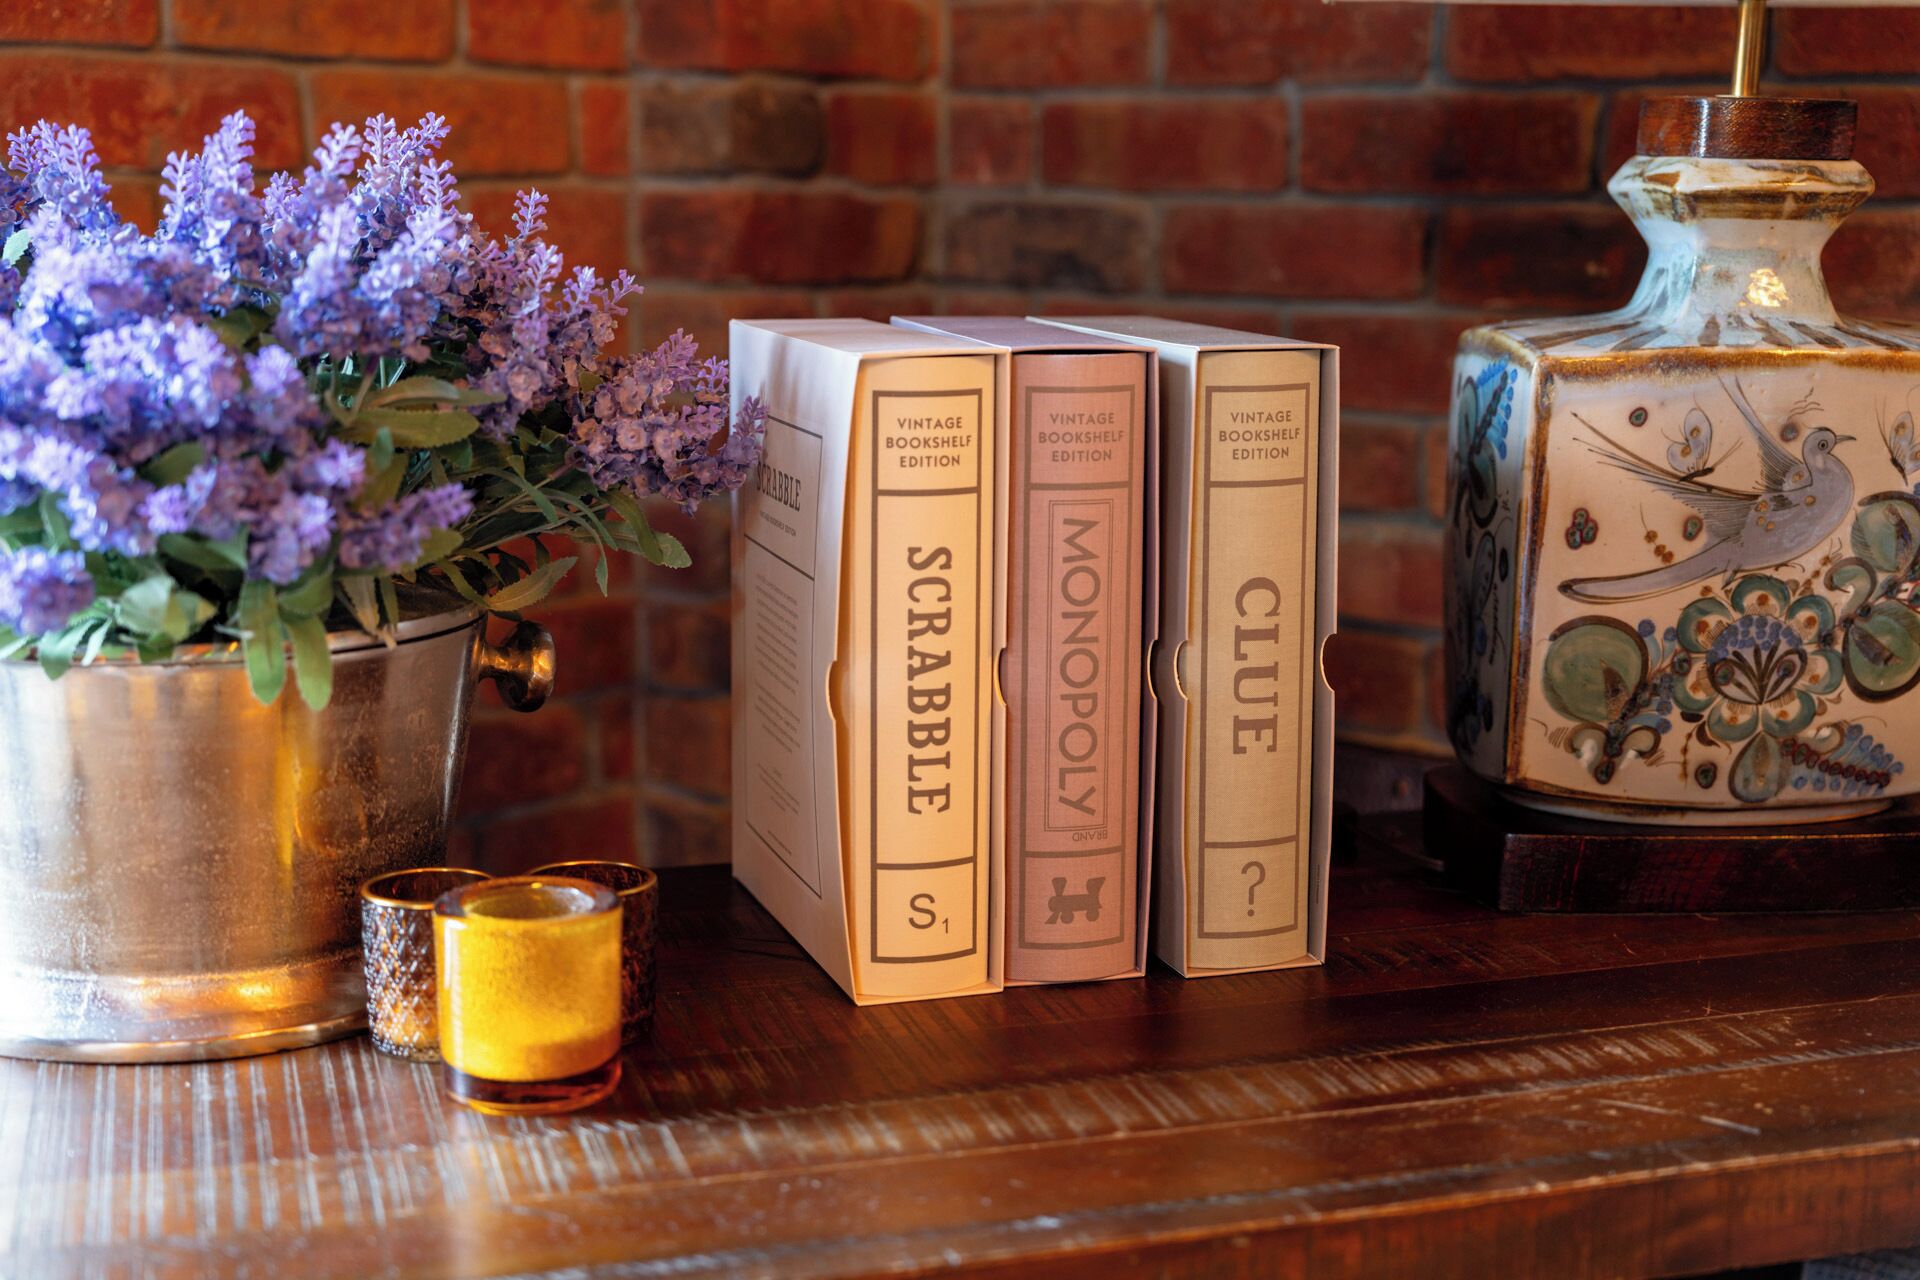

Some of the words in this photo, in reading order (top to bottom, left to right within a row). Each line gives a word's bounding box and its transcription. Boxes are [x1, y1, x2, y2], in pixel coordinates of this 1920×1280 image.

[897, 416, 963, 430] VINTAGE
[1049, 412, 1115, 425] VINTAGE
[1230, 410, 1292, 424] VINTAGE
[1038, 430, 1124, 444] BOOKSHELF
[1219, 427, 1301, 442] BOOKSHELF
[886, 435, 972, 449] BOOKSHELF
[1051, 449, 1112, 462] EDITION
[1232, 446, 1290, 460] EDITION
[899, 454, 961, 468] EDITION
[1058, 516, 1102, 817] MONOPOLY
[1232, 576, 1282, 755] CLUE
[906, 545, 953, 816] SCRABBLE
[1071, 830, 1108, 842] BRAND
